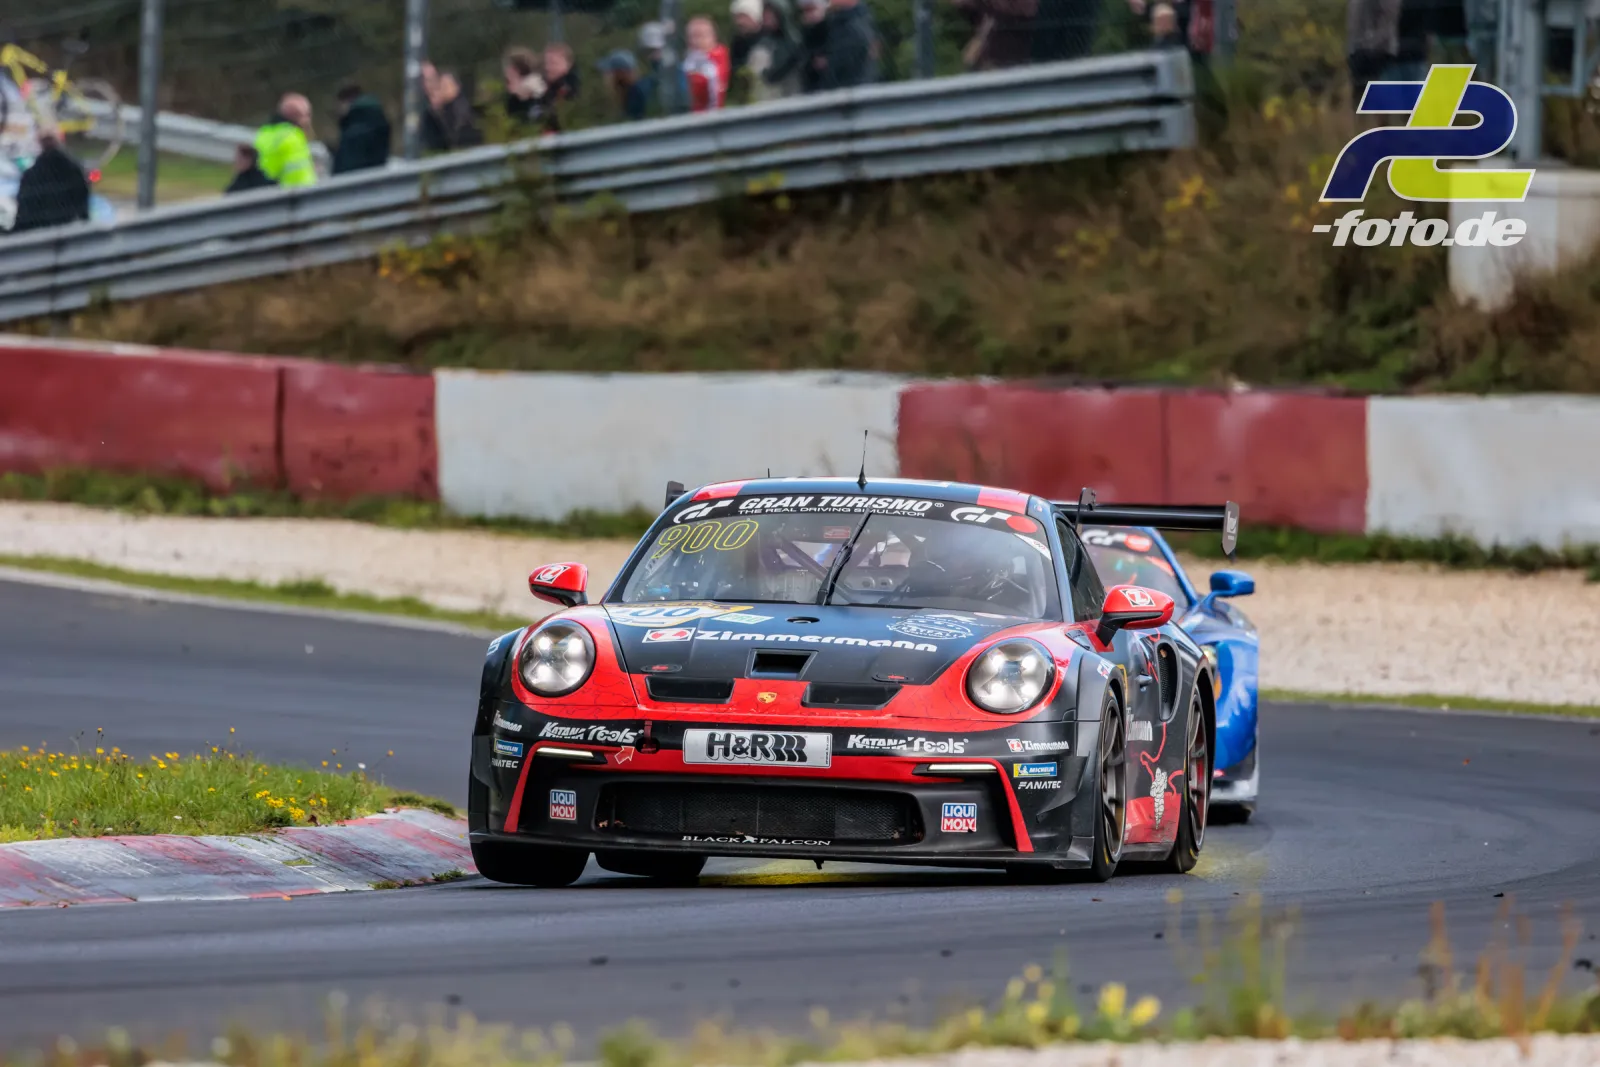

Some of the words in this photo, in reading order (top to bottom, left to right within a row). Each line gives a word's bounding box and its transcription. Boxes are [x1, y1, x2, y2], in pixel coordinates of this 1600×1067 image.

[738, 496, 814, 510] GRAN
[853, 507, 925, 517] SIMULATOR
[650, 520, 759, 559] 900
[695, 630, 938, 653] Zimmermann
[539, 721, 586, 740] KATANA
[847, 734, 907, 751] KATANA
[1018, 780, 1062, 790] FANATEC
[551, 791, 575, 806] LIQUI
[551, 804, 575, 818] MOLY
[943, 805, 976, 818] LIQUI
[943, 818, 976, 831] MOLY
[682, 835, 739, 843] BLACK
[759, 838, 831, 846] FALCON
